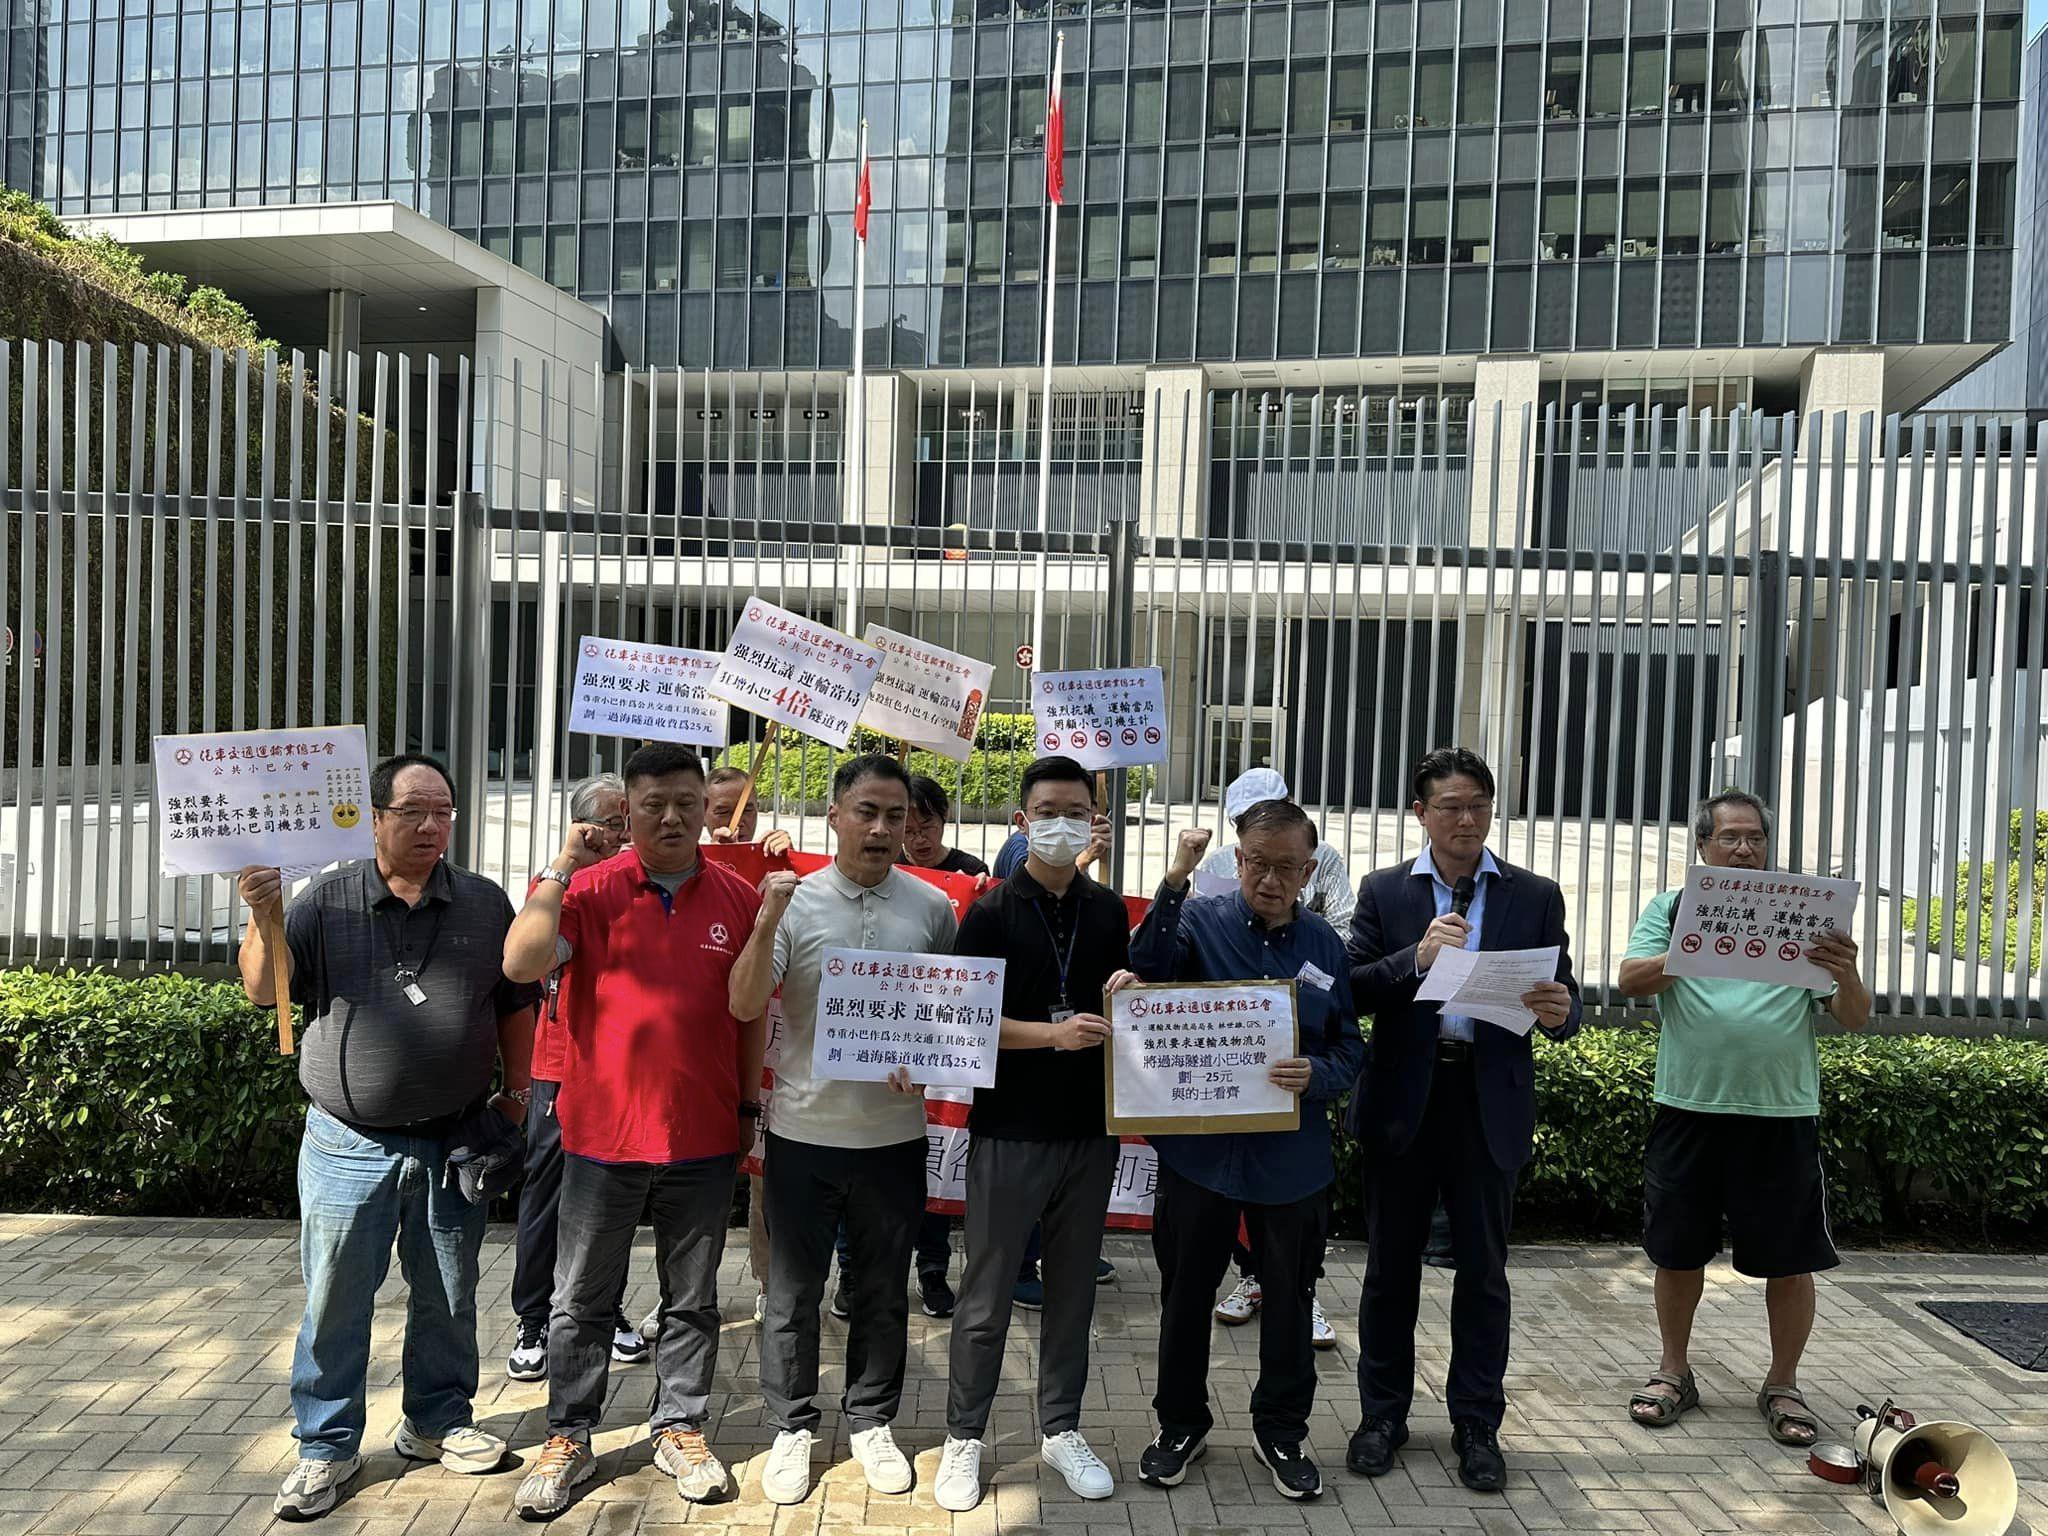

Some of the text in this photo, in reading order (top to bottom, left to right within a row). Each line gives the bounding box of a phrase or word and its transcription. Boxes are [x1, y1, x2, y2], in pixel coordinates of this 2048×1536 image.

[605, 648, 720, 670] 汽車交通運輸業總工
[798, 670, 861, 707] 運輸當局
[213, 761, 312, 776] 公共小巴分會
[1772, 911, 1835, 930] 運輸當局
[880, 981, 963, 997] 公共小巴分會
[914, 1002, 994, 1026] 運輸當局
[1143, 1051, 1267, 1070] 將過海隧道小巴收費
